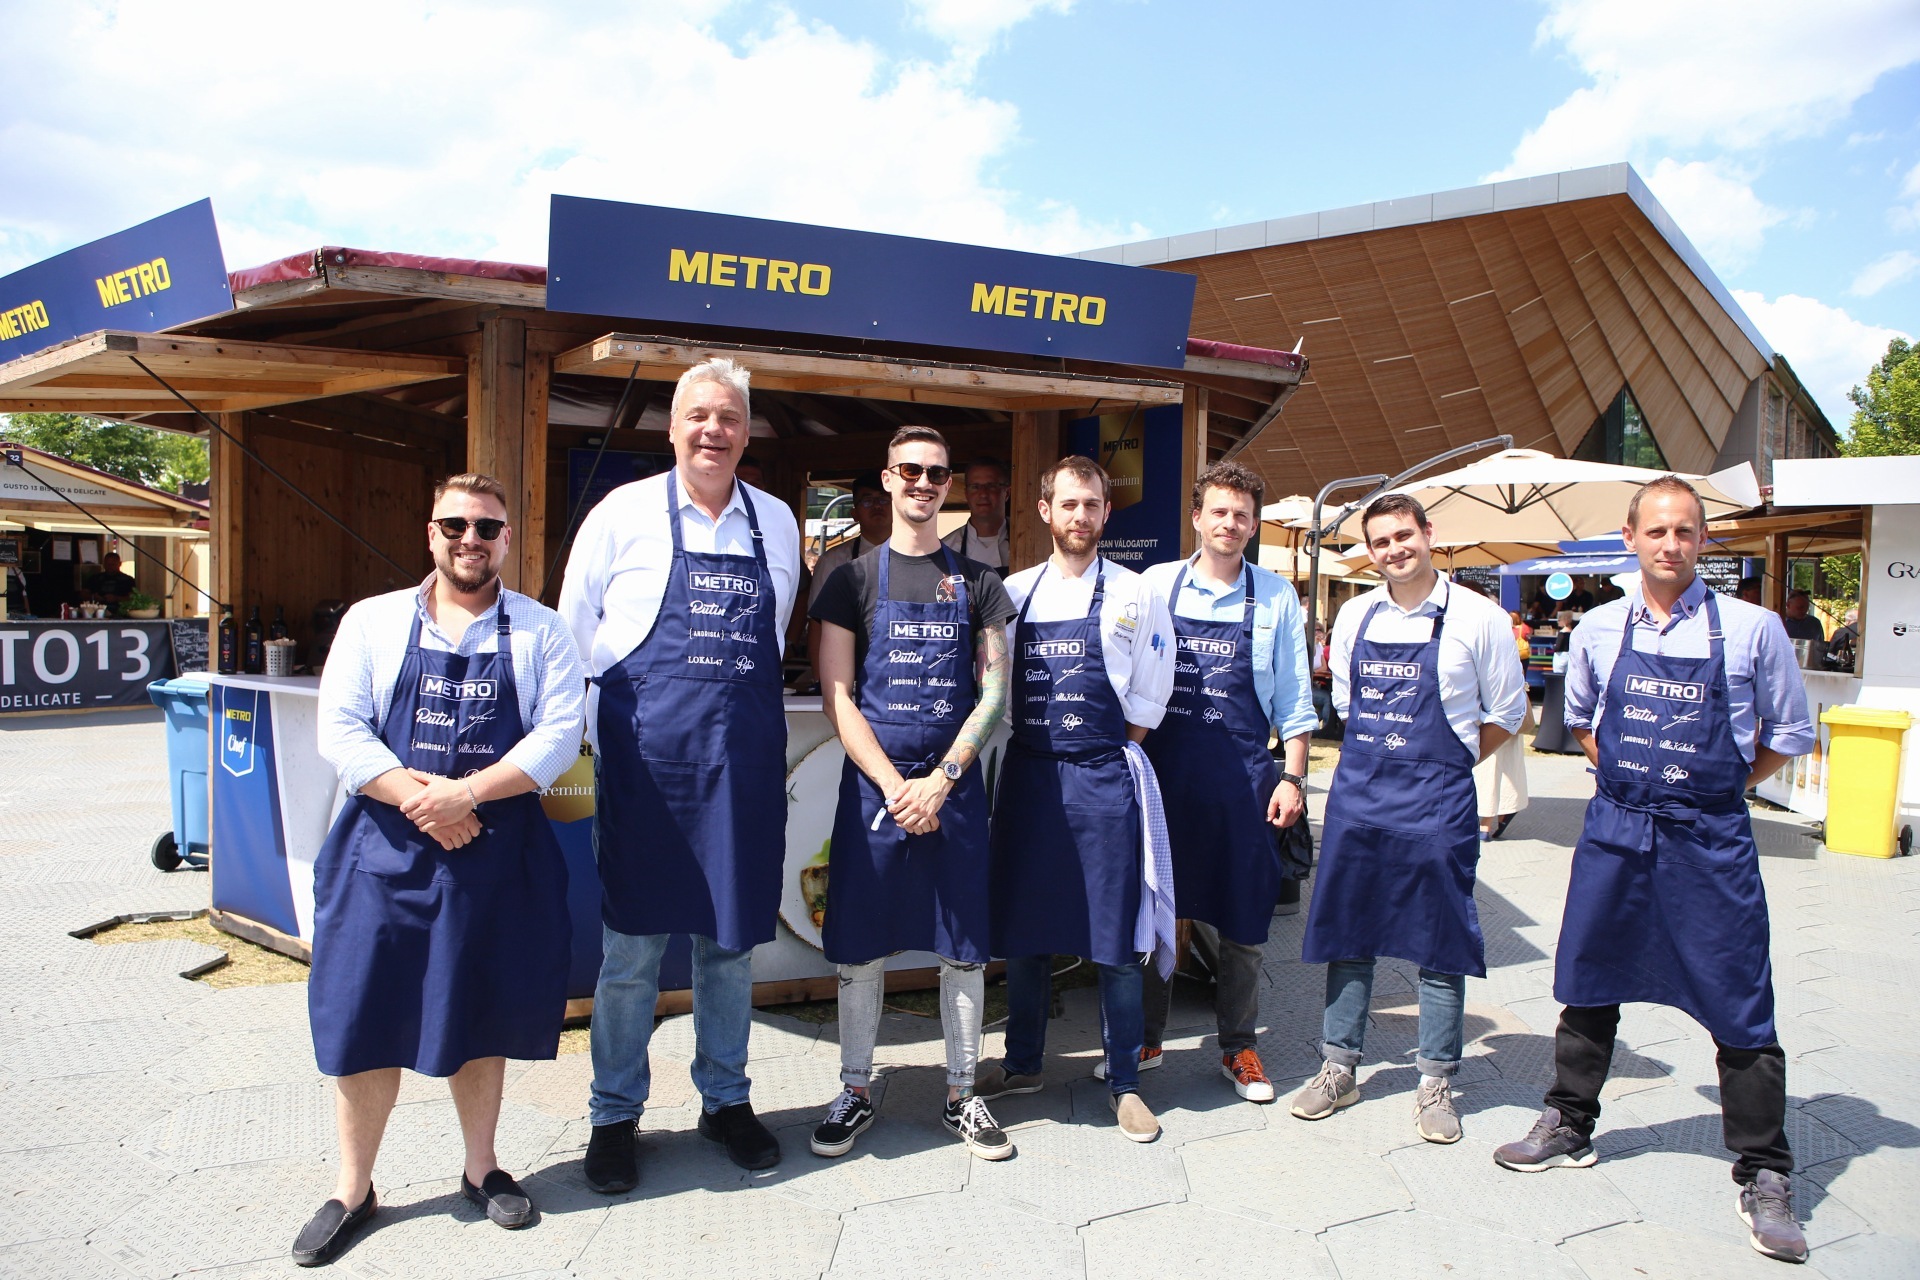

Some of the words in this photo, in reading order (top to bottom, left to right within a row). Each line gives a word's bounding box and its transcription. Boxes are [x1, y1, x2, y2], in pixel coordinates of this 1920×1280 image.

[669, 248, 833, 297] METRO
[96, 257, 172, 308] METRO
[970, 282, 1107, 326] METRO
[1109, 475, 1140, 487] emium
[73, 488, 107, 496] DELICATE
[1114, 538, 1158, 548] VÁLOGATOTT
[1109, 550, 1143, 560] TERMÉKEK
[694, 575, 754, 594] METRO
[689, 600, 727, 617] Rutin
[894, 624, 954, 638] METRO
[1027, 641, 1081, 656] METRO
[1178, 638, 1231, 655] METRO
[687, 655, 724, 667] LOKAL47
[888, 649, 924, 664] Rutin
[1025, 668, 1051, 682] Rutin
[1174, 660, 1200, 675] Rutin
[1362, 663, 1416, 678] METRO
[425, 678, 492, 698] METRO
[1360, 685, 1385, 700] Rutin
[1629, 678, 1699, 700] METRO
[1, 692, 81, 708] DELICATE
[887, 702, 921, 712] LOKAL47
[226, 708, 252, 722] METRO
[416, 707, 456, 727] Rutin
[1623, 704, 1659, 723] Rutin
[227, 734, 248, 759] Chef
[1617, 759, 1650, 774] LOKAL47
